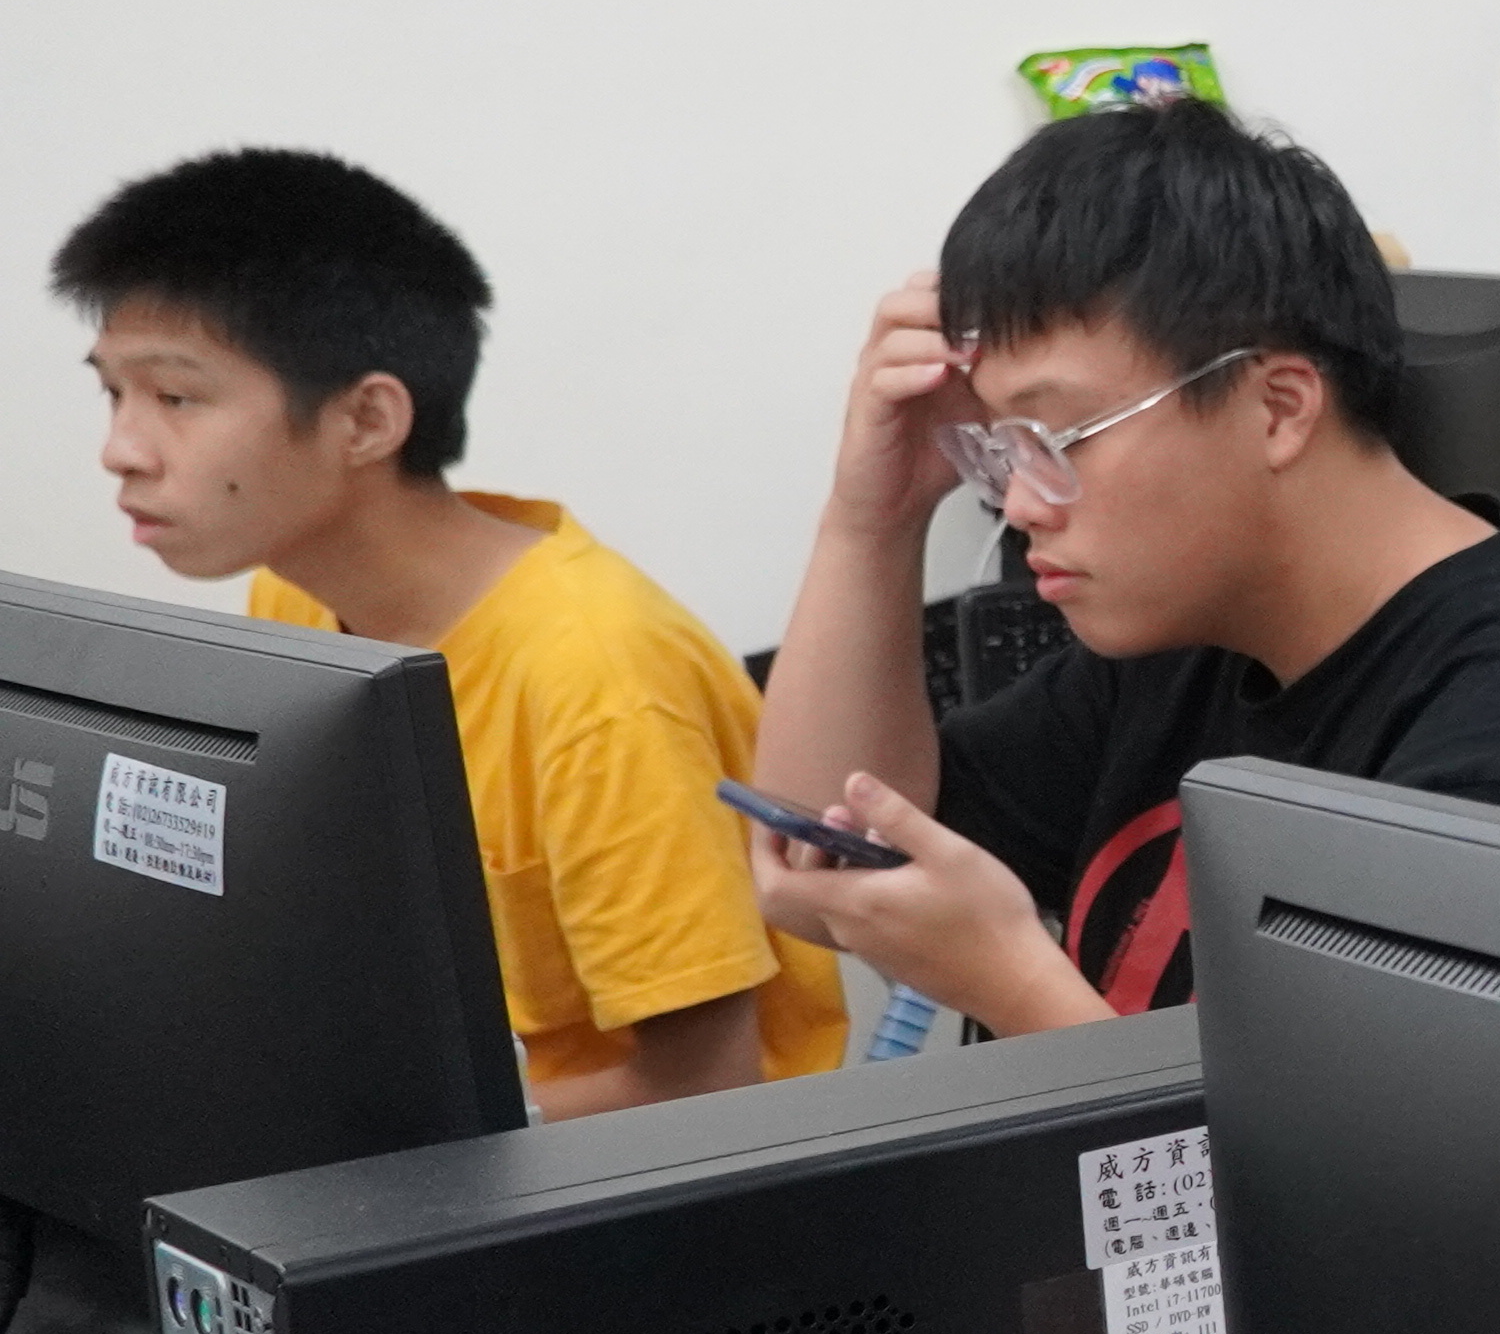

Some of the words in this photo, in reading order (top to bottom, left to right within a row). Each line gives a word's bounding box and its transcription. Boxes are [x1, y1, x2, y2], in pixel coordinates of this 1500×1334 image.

[1126, 1299, 1159, 1318] Intel
[1167, 1283, 1221, 1308] i7-11700
[1169, 1304, 1211, 1325] DVD-RW
